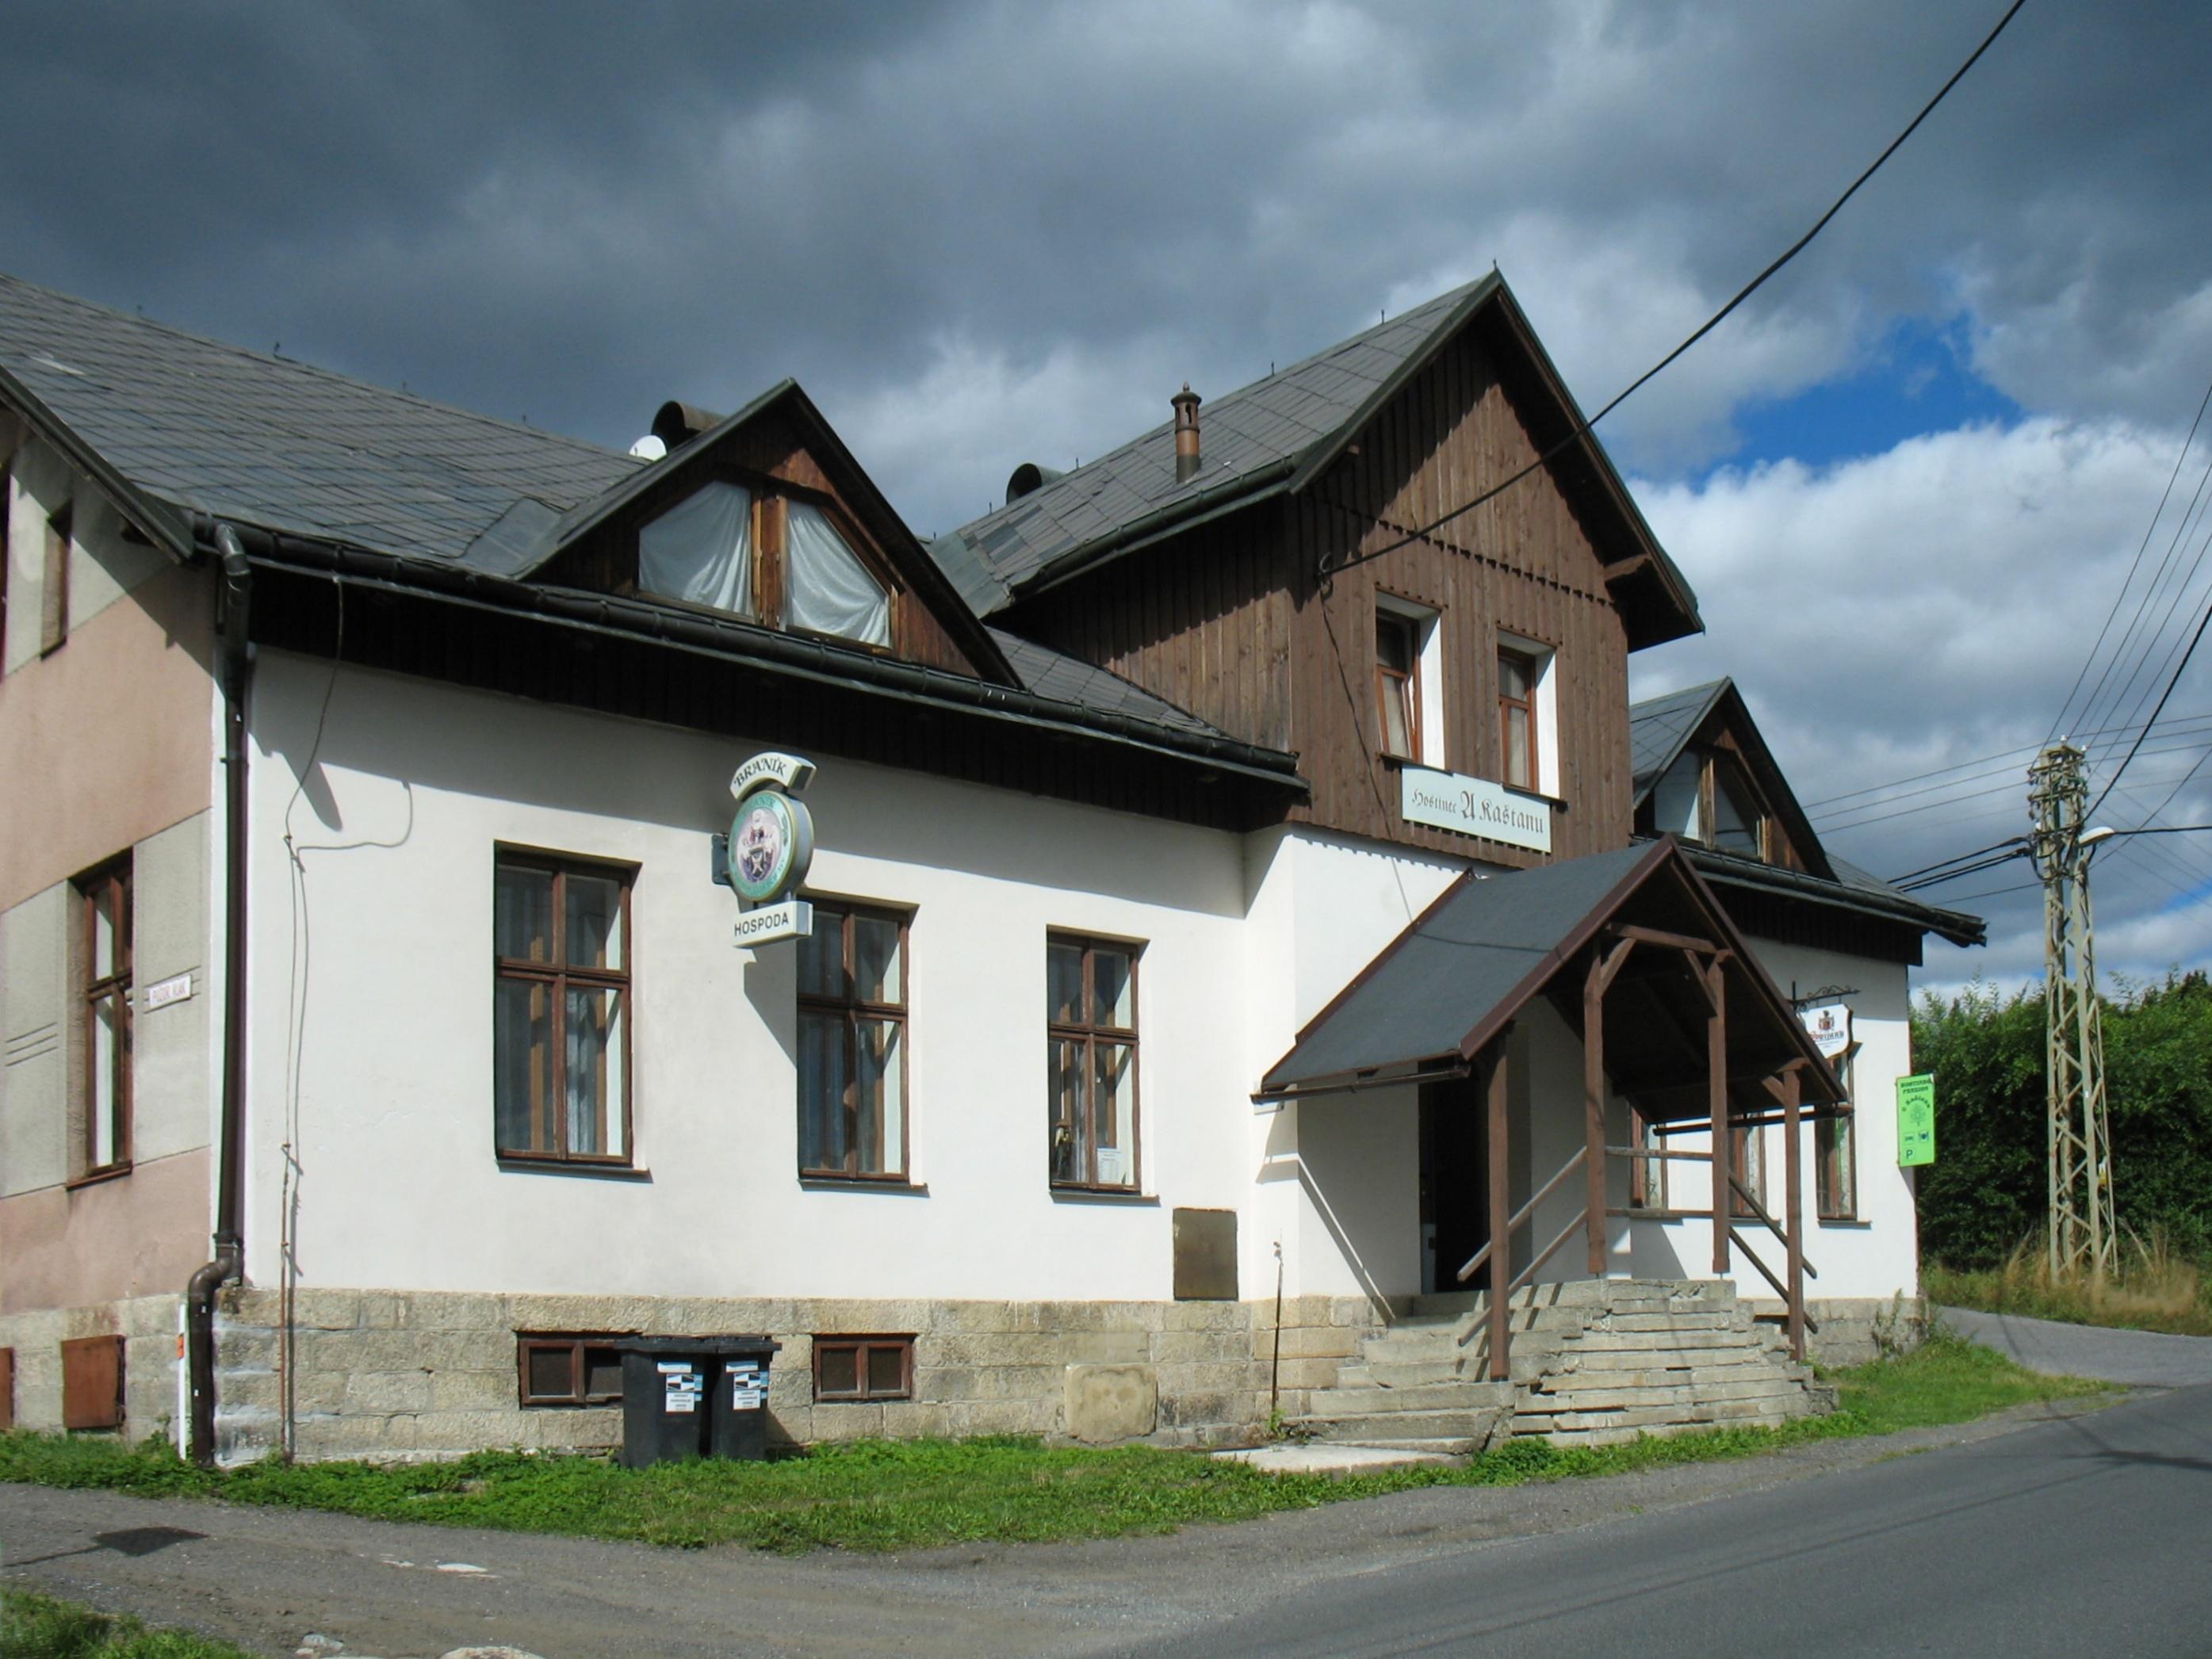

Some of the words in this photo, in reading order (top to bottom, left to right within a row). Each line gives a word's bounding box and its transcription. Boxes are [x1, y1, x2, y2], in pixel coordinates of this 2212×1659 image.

[733, 756, 787, 787] BRANÍK
[1411, 788, 1457, 814] Hostinec
[1479, 797, 1544, 834] Kaštanu
[734, 912, 789, 936] HOSPODA
[1905, 1149, 1913, 1159] P
